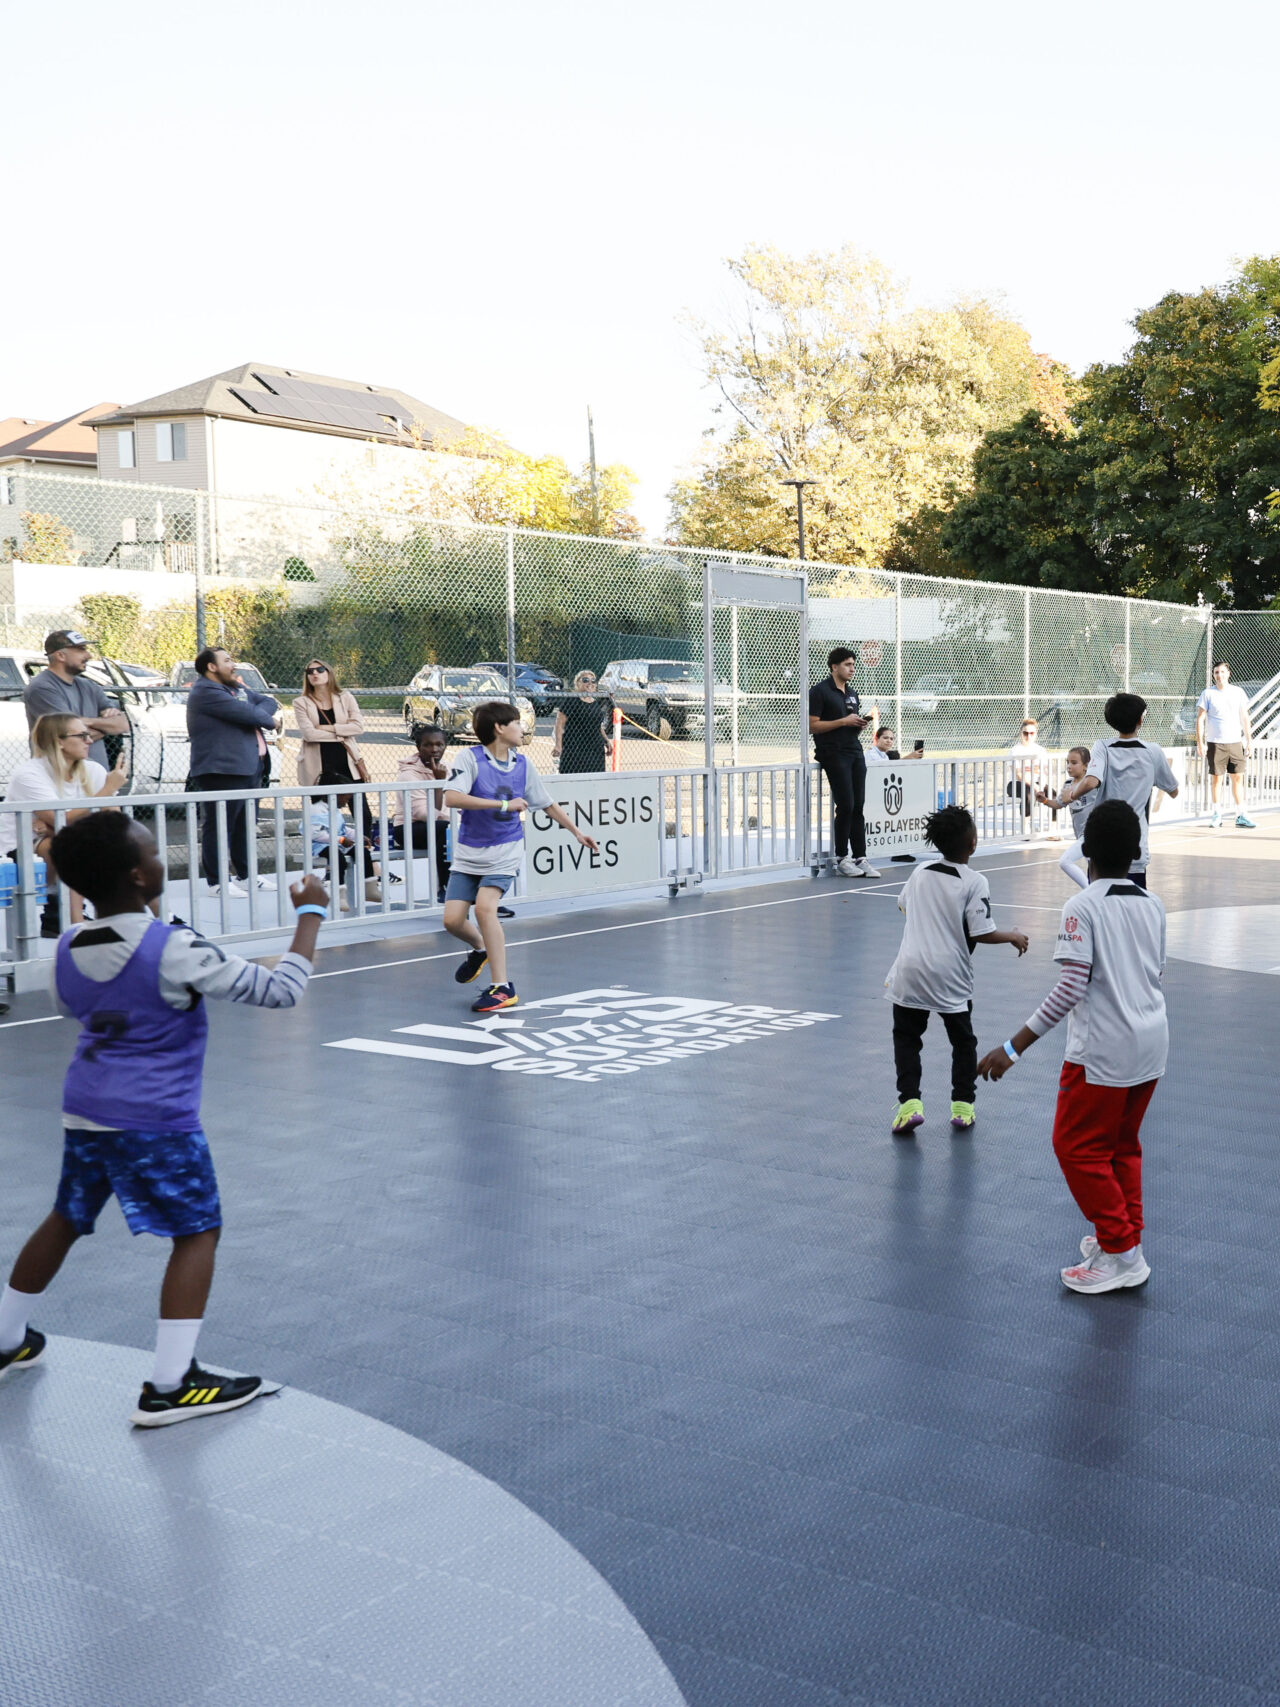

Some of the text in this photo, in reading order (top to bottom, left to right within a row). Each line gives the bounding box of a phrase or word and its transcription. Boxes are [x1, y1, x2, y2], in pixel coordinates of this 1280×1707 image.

[867, 832, 927, 847] SSOCIATION
[884, 817, 927, 834] PLAYERS
[533, 840, 619, 875] GIVES
[490, 1004, 801, 1075] SOCCER
[552, 1010, 843, 1083] FOUNDATION
